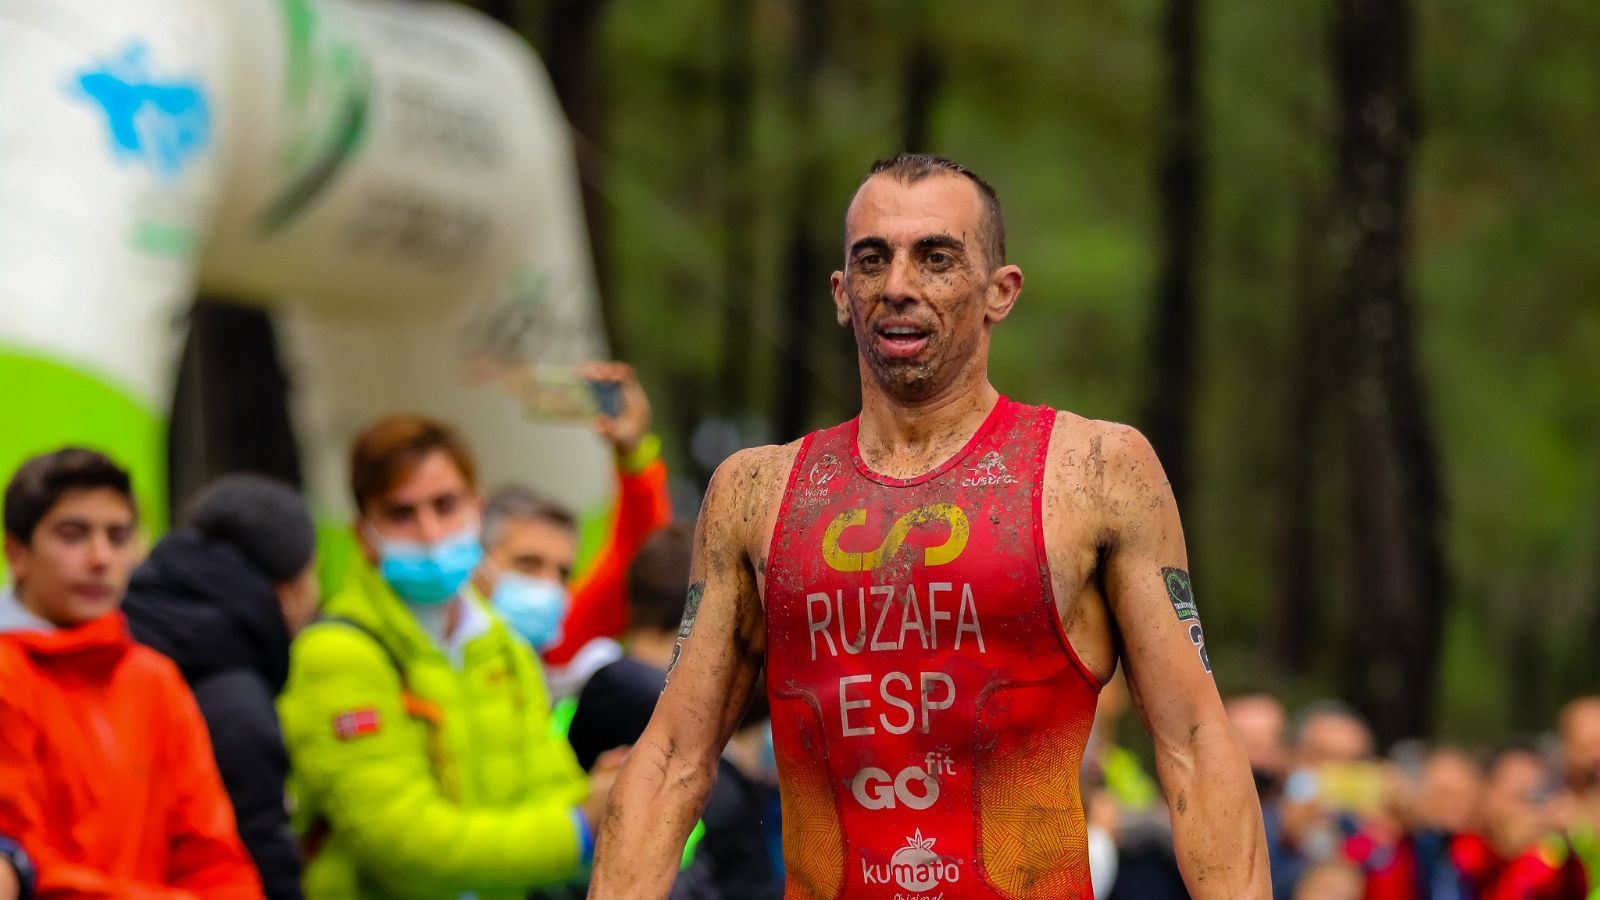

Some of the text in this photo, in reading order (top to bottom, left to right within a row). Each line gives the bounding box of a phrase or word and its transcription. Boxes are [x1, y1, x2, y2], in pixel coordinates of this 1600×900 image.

[806, 582, 986, 661] RUZAFA
[839, 671, 956, 737] ESP
[852, 752, 957, 811] GO fit
[861, 857, 960, 884] kumato
